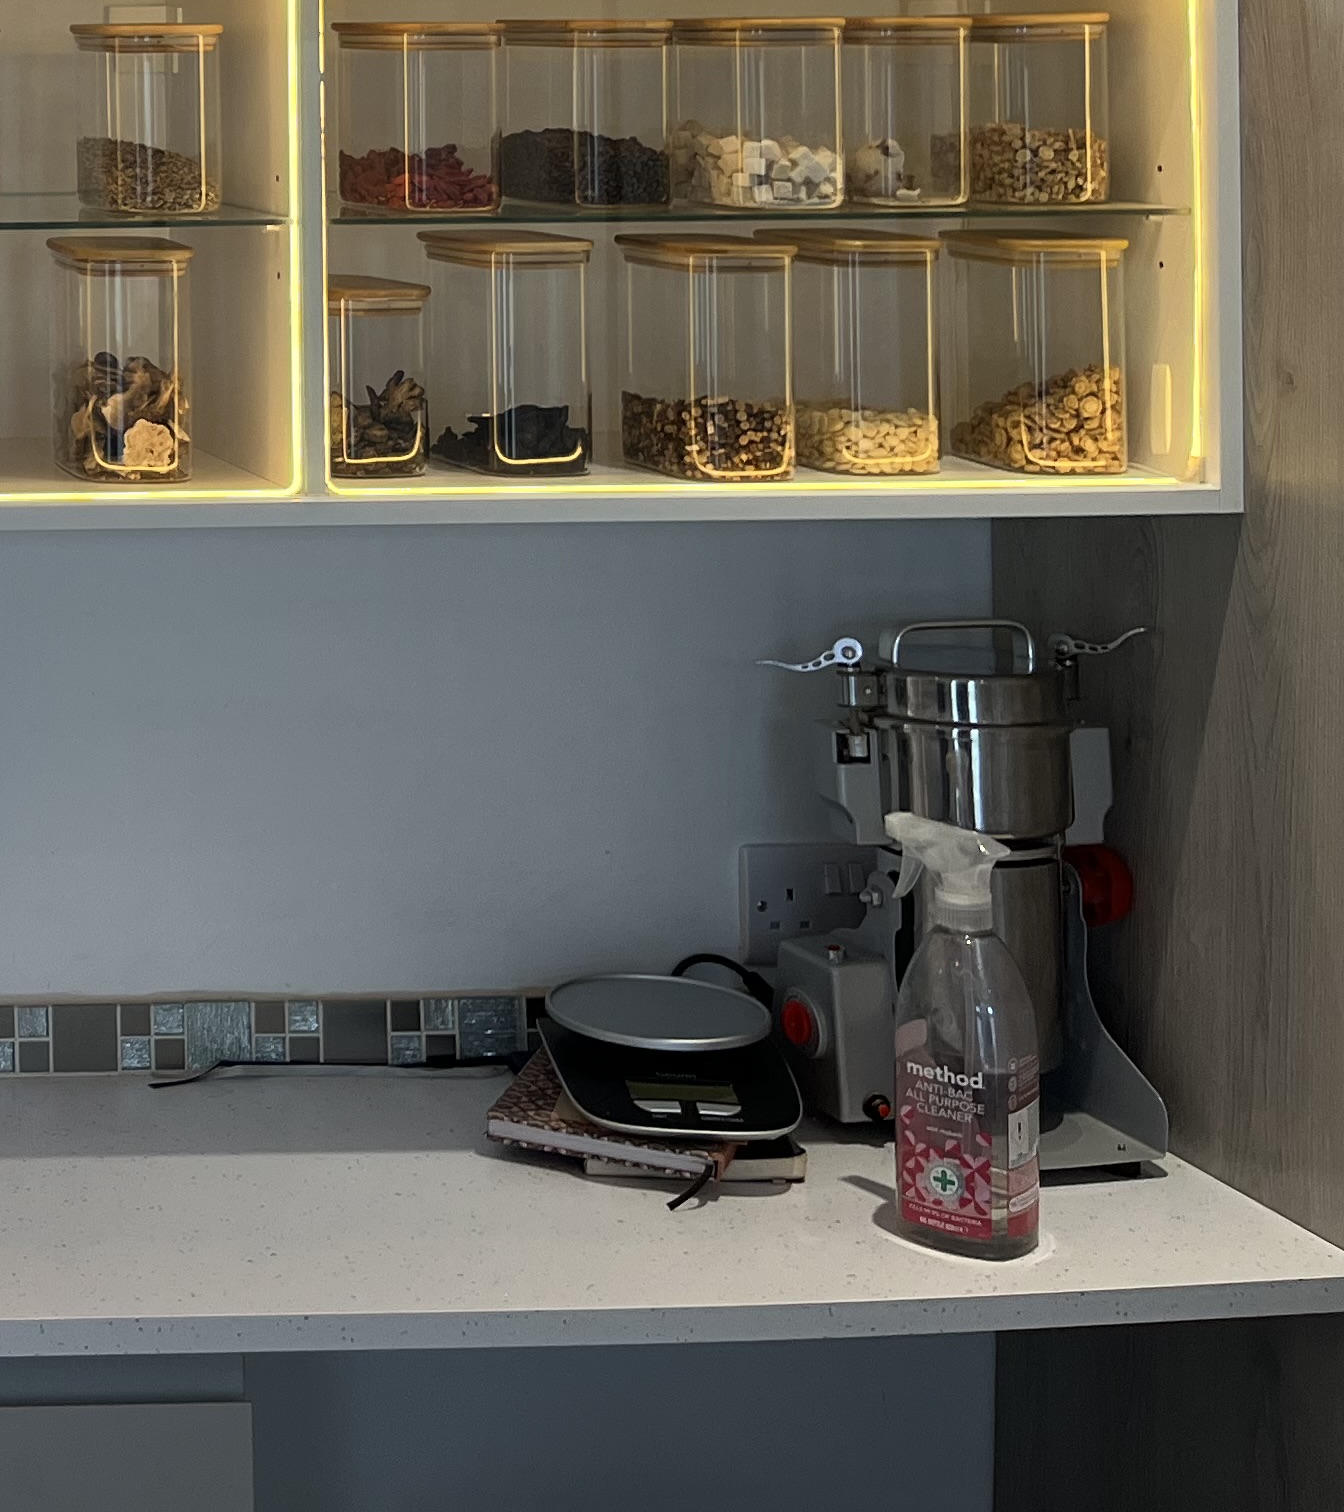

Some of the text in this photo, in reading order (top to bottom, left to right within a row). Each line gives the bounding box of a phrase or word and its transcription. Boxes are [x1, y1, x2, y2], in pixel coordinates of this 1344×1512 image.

[906, 1060, 983, 1089] method
[905, 1087, 985, 1115] ALL PURPOSE
[915, 1079, 973, 1102] ANTI-BAC
[916, 1102, 972, 1124] CLEANER
